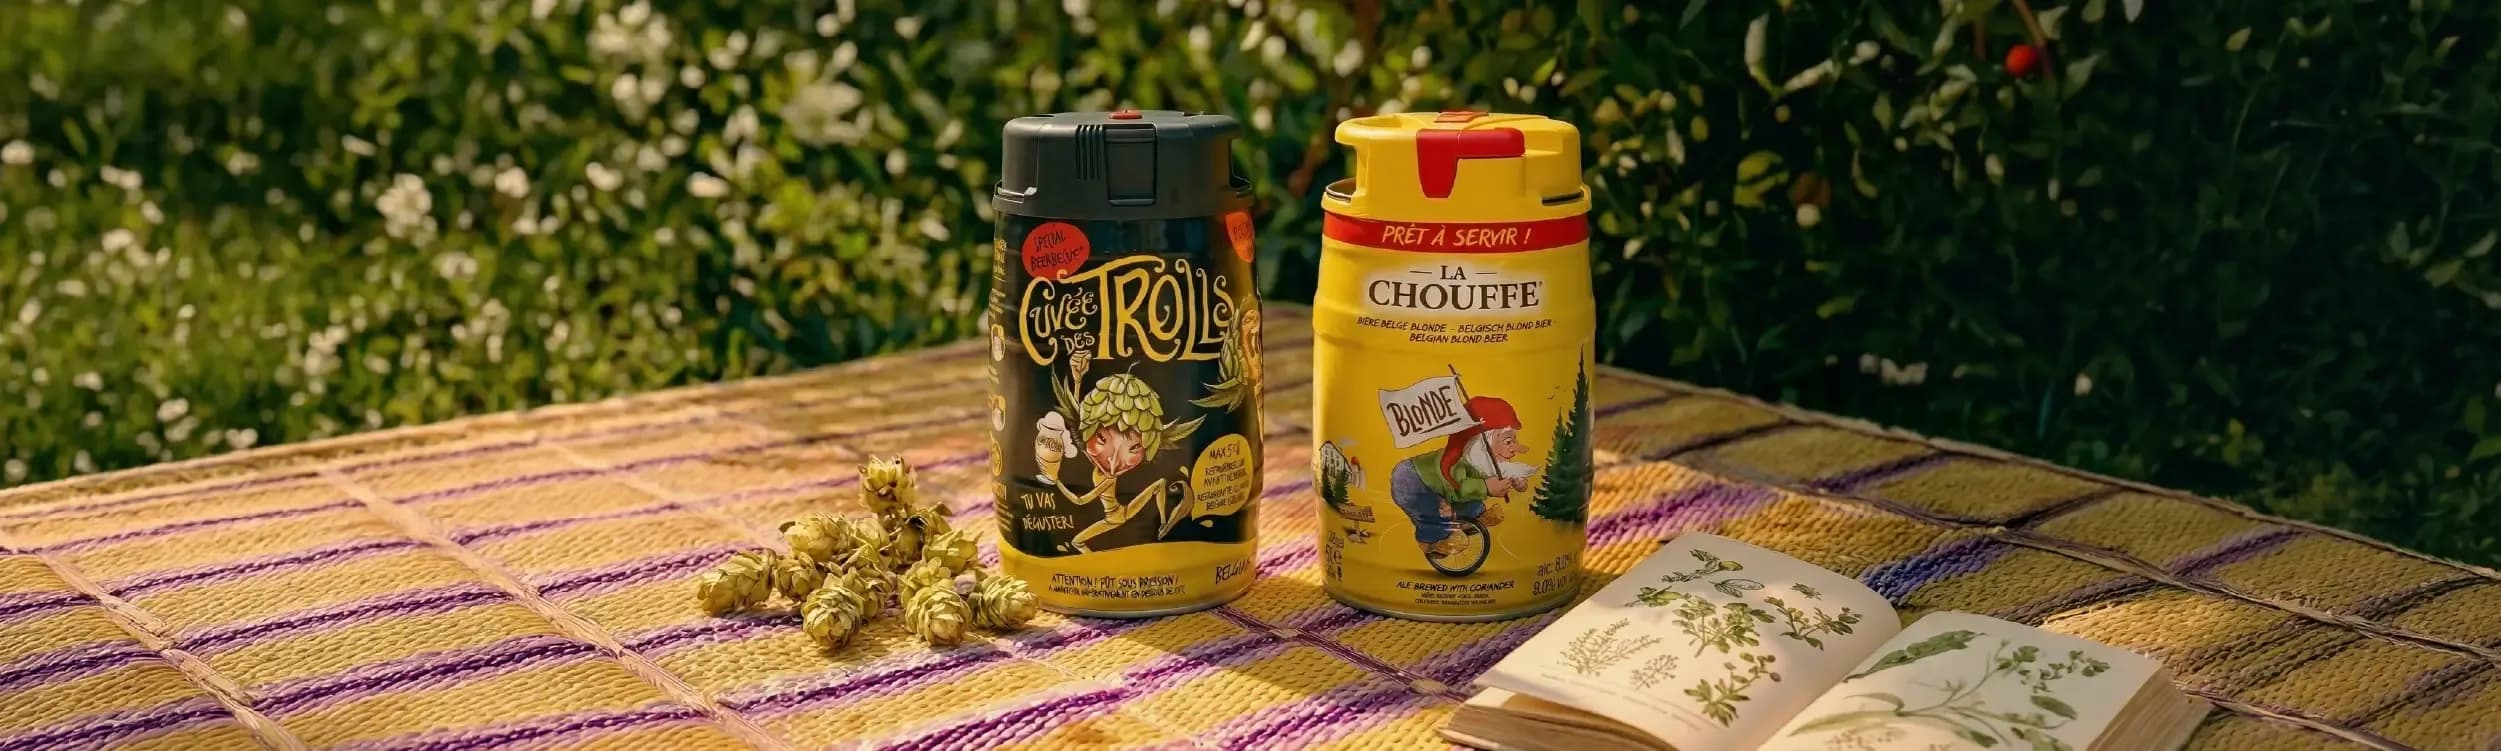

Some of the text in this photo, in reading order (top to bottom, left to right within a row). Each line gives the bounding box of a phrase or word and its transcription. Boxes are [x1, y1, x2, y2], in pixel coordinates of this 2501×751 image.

[1382, 224, 1430, 246] PRÊT
[1431, 225, 1447, 246] À
[1452, 228, 1517, 247] SERVIR
[1440, 265, 1466, 280] LA
[1058, 255, 1235, 363] TROLLS
[1380, 320, 1408, 330] BELGE
[1410, 322, 1447, 333] BLONDE
[1458, 324, 1504, 334] BELGISCH
[1506, 322, 1534, 332] BLOND
[1535, 319, 1553, 328] BIER
[1409, 333, 1508, 344] BELGIAN BLOND BEER
[1387, 385, 1458, 437] BLONDE
[1021, 491, 1056, 511] TU VAS
[1396, 580, 1516, 592] ALE BREWED WITH CORIANDER
